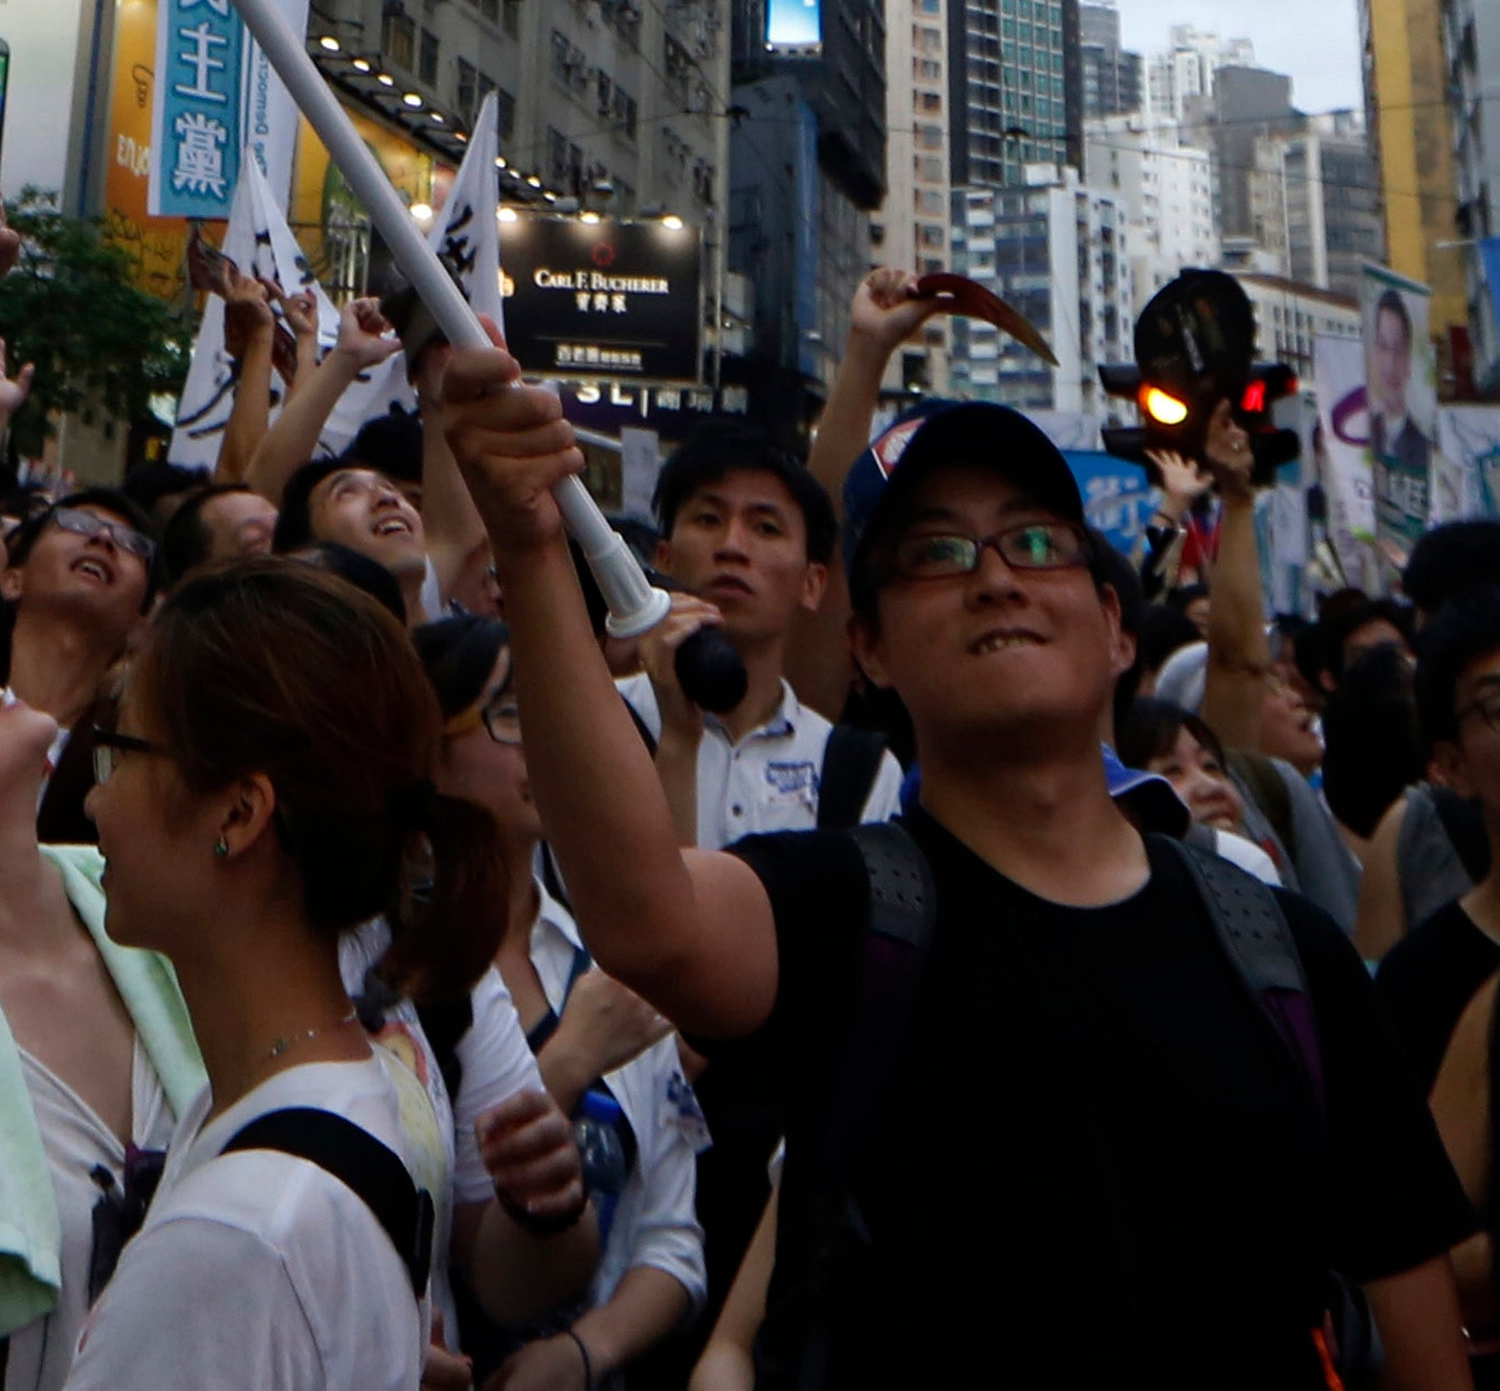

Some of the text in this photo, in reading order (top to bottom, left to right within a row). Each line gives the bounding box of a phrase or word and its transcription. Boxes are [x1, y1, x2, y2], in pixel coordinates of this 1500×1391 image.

[117, 132, 152, 179] ENJO
[533, 269, 669, 294] CARL F. BUCHERER
